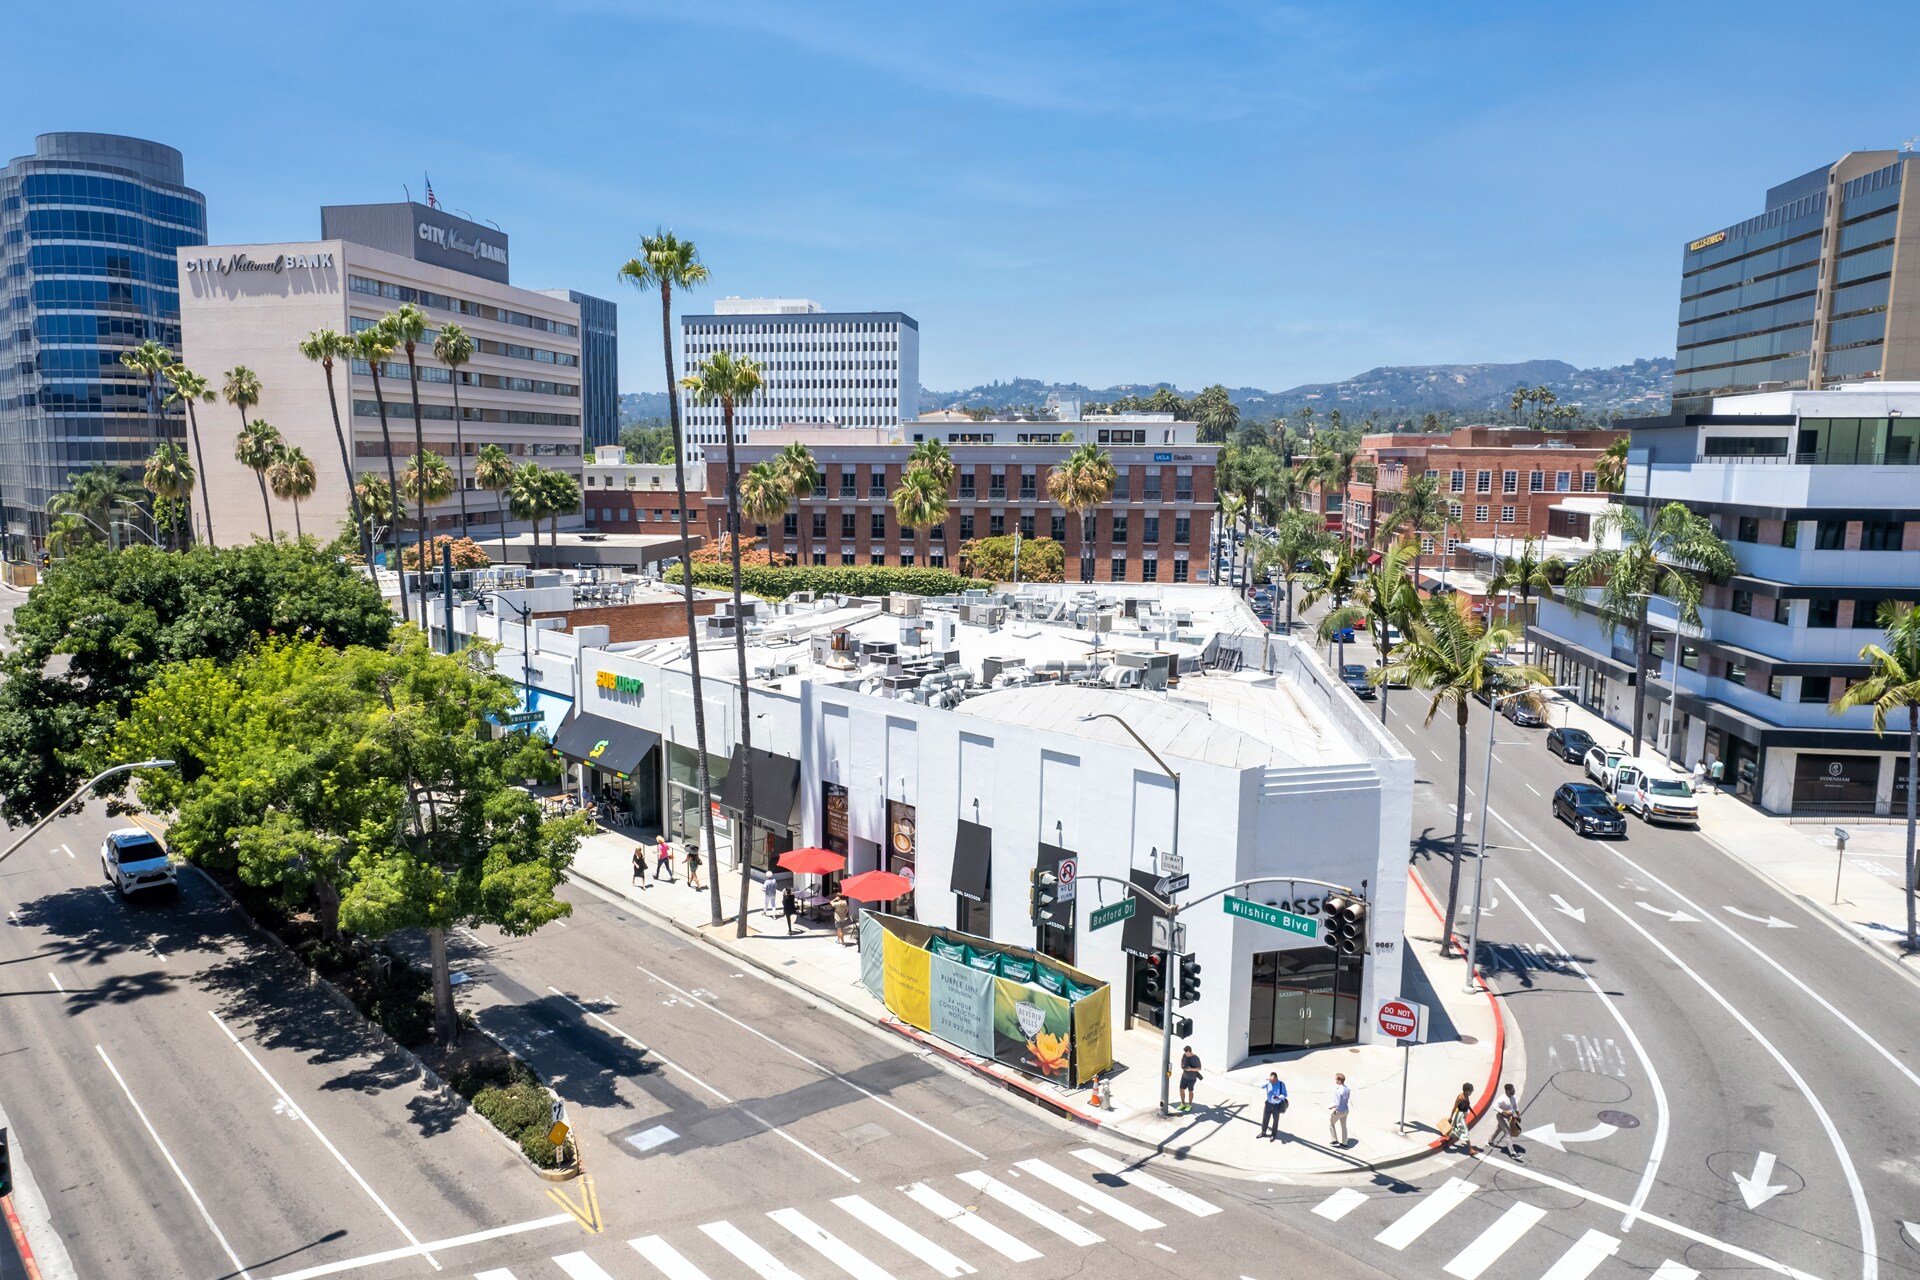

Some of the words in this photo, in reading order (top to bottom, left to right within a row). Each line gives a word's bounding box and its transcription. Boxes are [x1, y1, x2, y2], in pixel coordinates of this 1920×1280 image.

[418, 223, 445, 245] CITY
[442, 228, 480, 259] National
[480, 242, 507, 265] BANK
[185, 257, 222, 272] CITY
[221, 253, 284, 276] National
[285, 253, 333, 269] BANK
[596, 671, 642, 694] SUBWAY
[1163, 862, 1180, 871] SIGNAL
[1093, 907, 1122, 926] Bedford
[1124, 904, 1133, 915] Dr
[1232, 902, 1277, 922] Wilshire
[1283, 916, 1309, 932] Blvd
[1125, 947, 1138, 957] VIDAL
[941, 974, 963, 989] PURPLE
[938, 1000, 981, 1022] CONSTRUCTION
[957, 1001, 971, 1011] HOUR
[1384, 1006, 1394, 1015] DO
[1397, 1008, 1411, 1018] NOT
[948, 1010, 971, 1025] HOTLINE
[1018, 1008, 1042, 1021] BEVERLY
[1021, 1016, 1038, 1029] HILLS
[1386, 1022, 1408, 1033] ENTER
